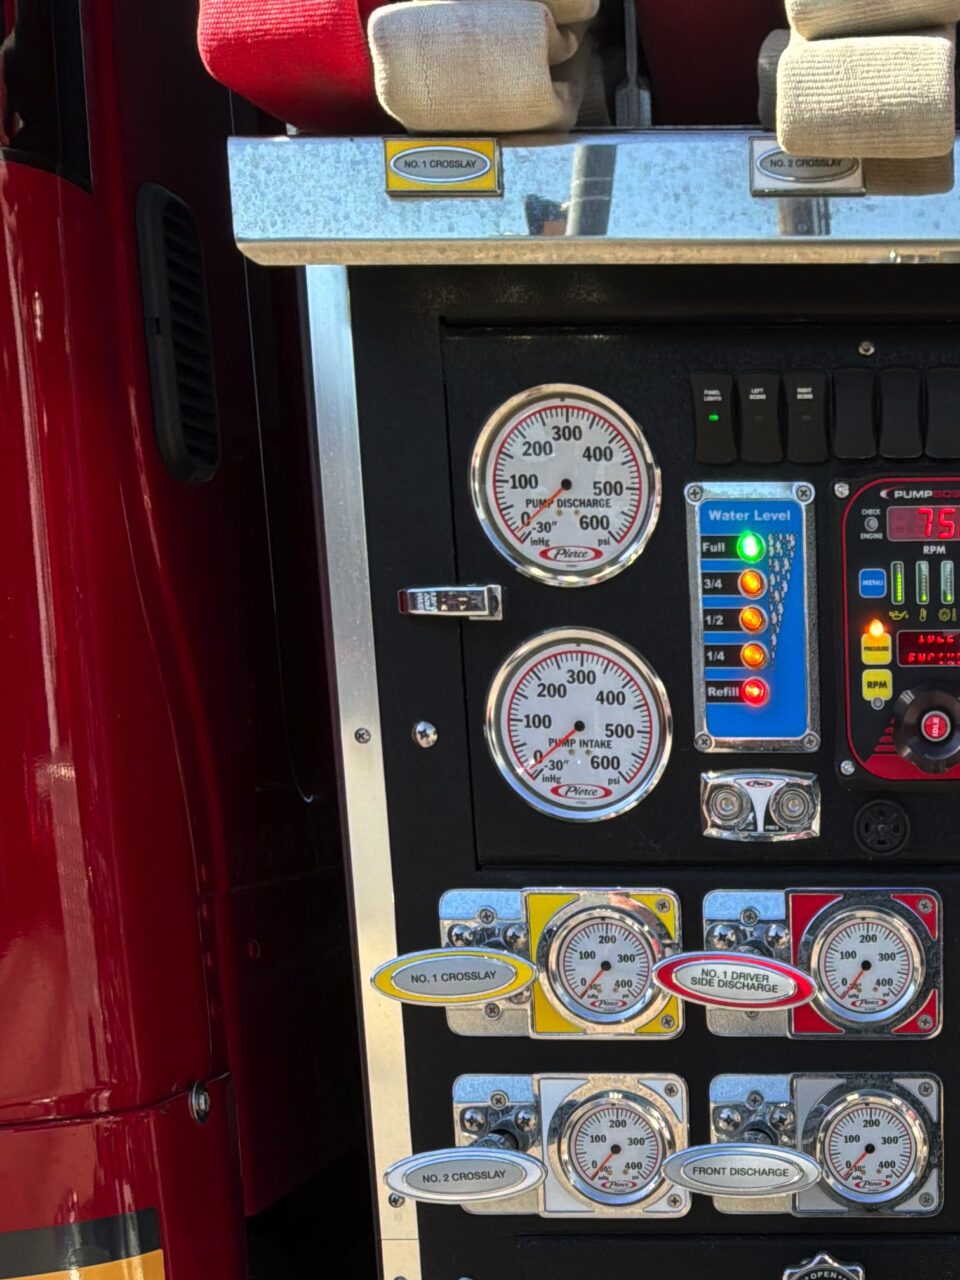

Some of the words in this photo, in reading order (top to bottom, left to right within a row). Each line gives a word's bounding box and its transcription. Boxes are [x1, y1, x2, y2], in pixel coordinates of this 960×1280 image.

[404, 160, 419, 168] NO.
[430, 160, 476, 168] CROSSLAY
[770, 159, 786, 167] NO.
[552, 426, 582, 441] 300
[523, 441, 553, 456] 200
[583, 447, 613, 462] 400
[510, 474, 538, 489] 100
[593, 481, 623, 496] 500
[526, 499, 553, 508] PUMP
[557, 499, 611, 508] DISCHARGE
[709, 509, 750, 521] Water
[754, 509, 791, 521] Level
[580, 516, 609, 530] 600
[702, 542, 725, 553] Full
[923, 545, 946, 555] RPM
[554, 547, 589, 560] Pierce
[704, 579, 722, 590] 3/4
[705, 615, 724, 626] 1/2
[706, 651, 725, 661] 1/4
[567, 670, 596, 685] 300
[537, 683, 567, 698] 200
[867, 681, 887, 689] RPM
[708, 686, 740, 697] Refill
[596, 691, 625, 705] 400
[524, 714, 552, 729] 100
[932, 717, 940, 737] IDLE
[605, 724, 634, 738] 500
[549, 738, 576, 748] PUMP
[579, 739, 612, 749] INTAKE
[591, 756, 620, 770] 600
[565, 786, 598, 797] Pierce
[598, 936, 616, 944] 200
[859, 934, 877, 944] 200
[579, 951, 596, 960] 100
[617, 954, 635, 963] 300
[840, 951, 856, 960] 100
[878, 952, 896, 962] 300
[411, 974, 430, 984] NO.
[441, 971, 496, 982] CROSSLAY
[701, 968, 720, 978] NO.
[731, 972, 769, 982] DRIVER
[614, 980, 633, 988] 400
[690, 976, 716, 988] SIDE
[717, 978, 778, 994] DISCHARGE
[875, 978, 893, 988] 400
[609, 1120, 627, 1128] 200
[862, 1119, 880, 1128] 200
[590, 1135, 606, 1144] 100
[627, 1137, 645, 1146] 300
[844, 1135, 860, 1144] 100
[881, 1136, 898, 1145] 300
[624, 1162, 642, 1170] 400
[878, 1160, 896, 1170] 400
[422, 1174, 442, 1184] NO.
[443, 1174, 449, 1182] 2
[452, 1170, 506, 1182] CROSSLAY
[692, 1166, 726, 1176] FRONT
[729, 1166, 789, 1178] DISCHARGE
[810, 1271, 837, 1280] OPEN
